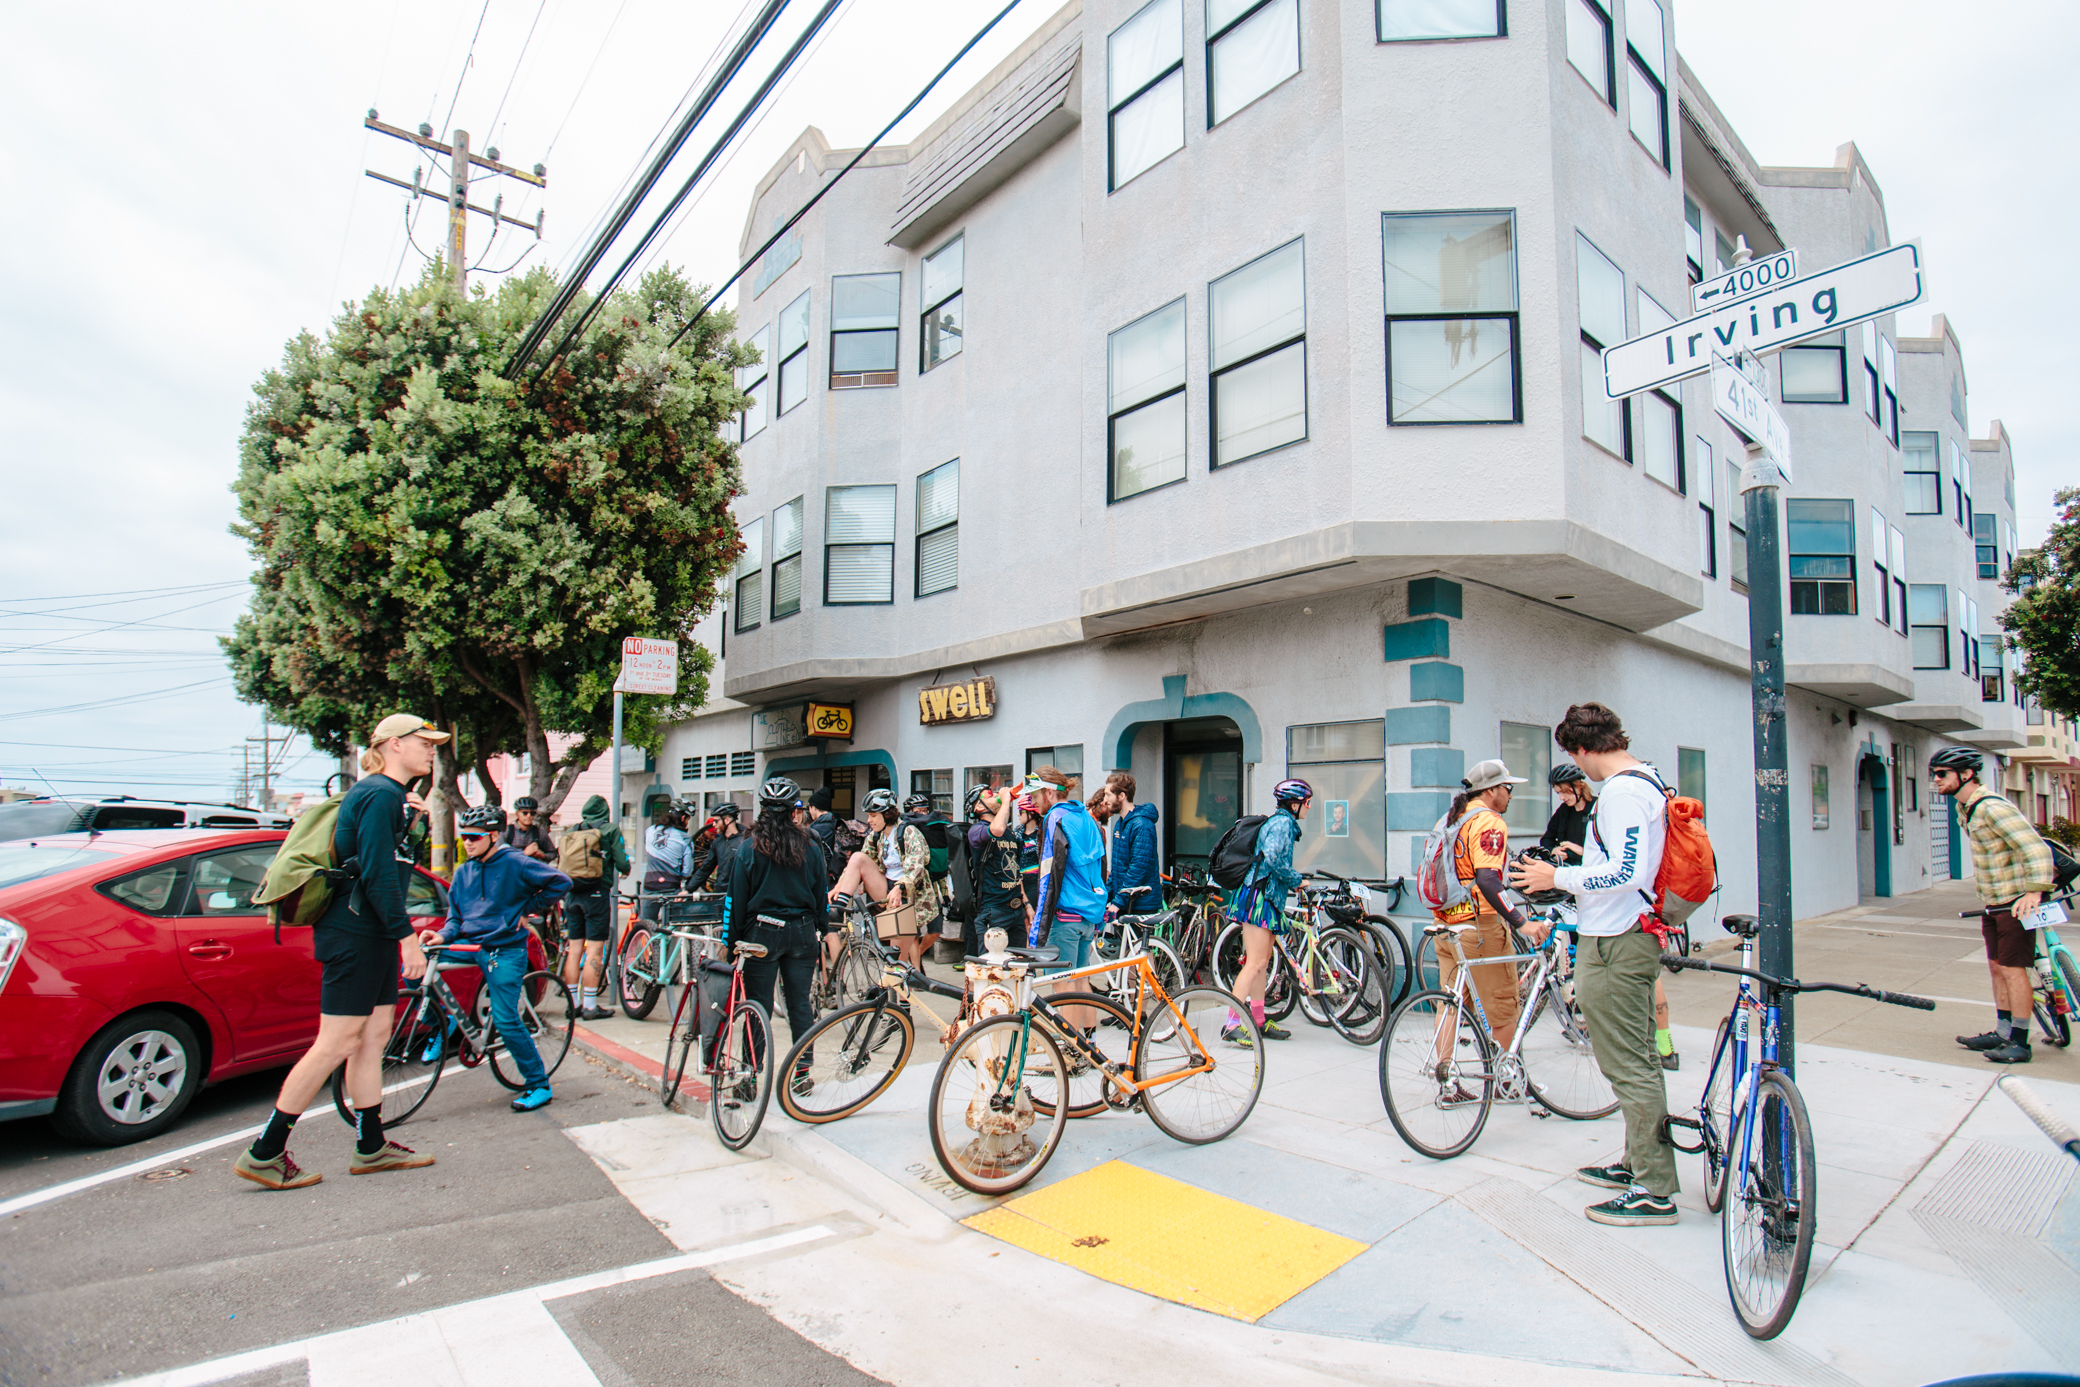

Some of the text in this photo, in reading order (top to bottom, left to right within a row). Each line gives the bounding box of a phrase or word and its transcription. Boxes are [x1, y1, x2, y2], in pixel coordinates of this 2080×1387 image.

[1722, 257, 1790, 296] 4000
[1664, 286, 1838, 366] Irving
[1727, 378, 1758, 422] 41st
[627, 639, 675, 657] NO PARKING
[630, 657, 638, 668] 12
[657, 659, 663, 670] 2
[648, 684, 672, 692] CLEANING
[1583, 826, 1640, 891] WAVELENGTHS
[905, 1162, 971, 1201] IRVING
